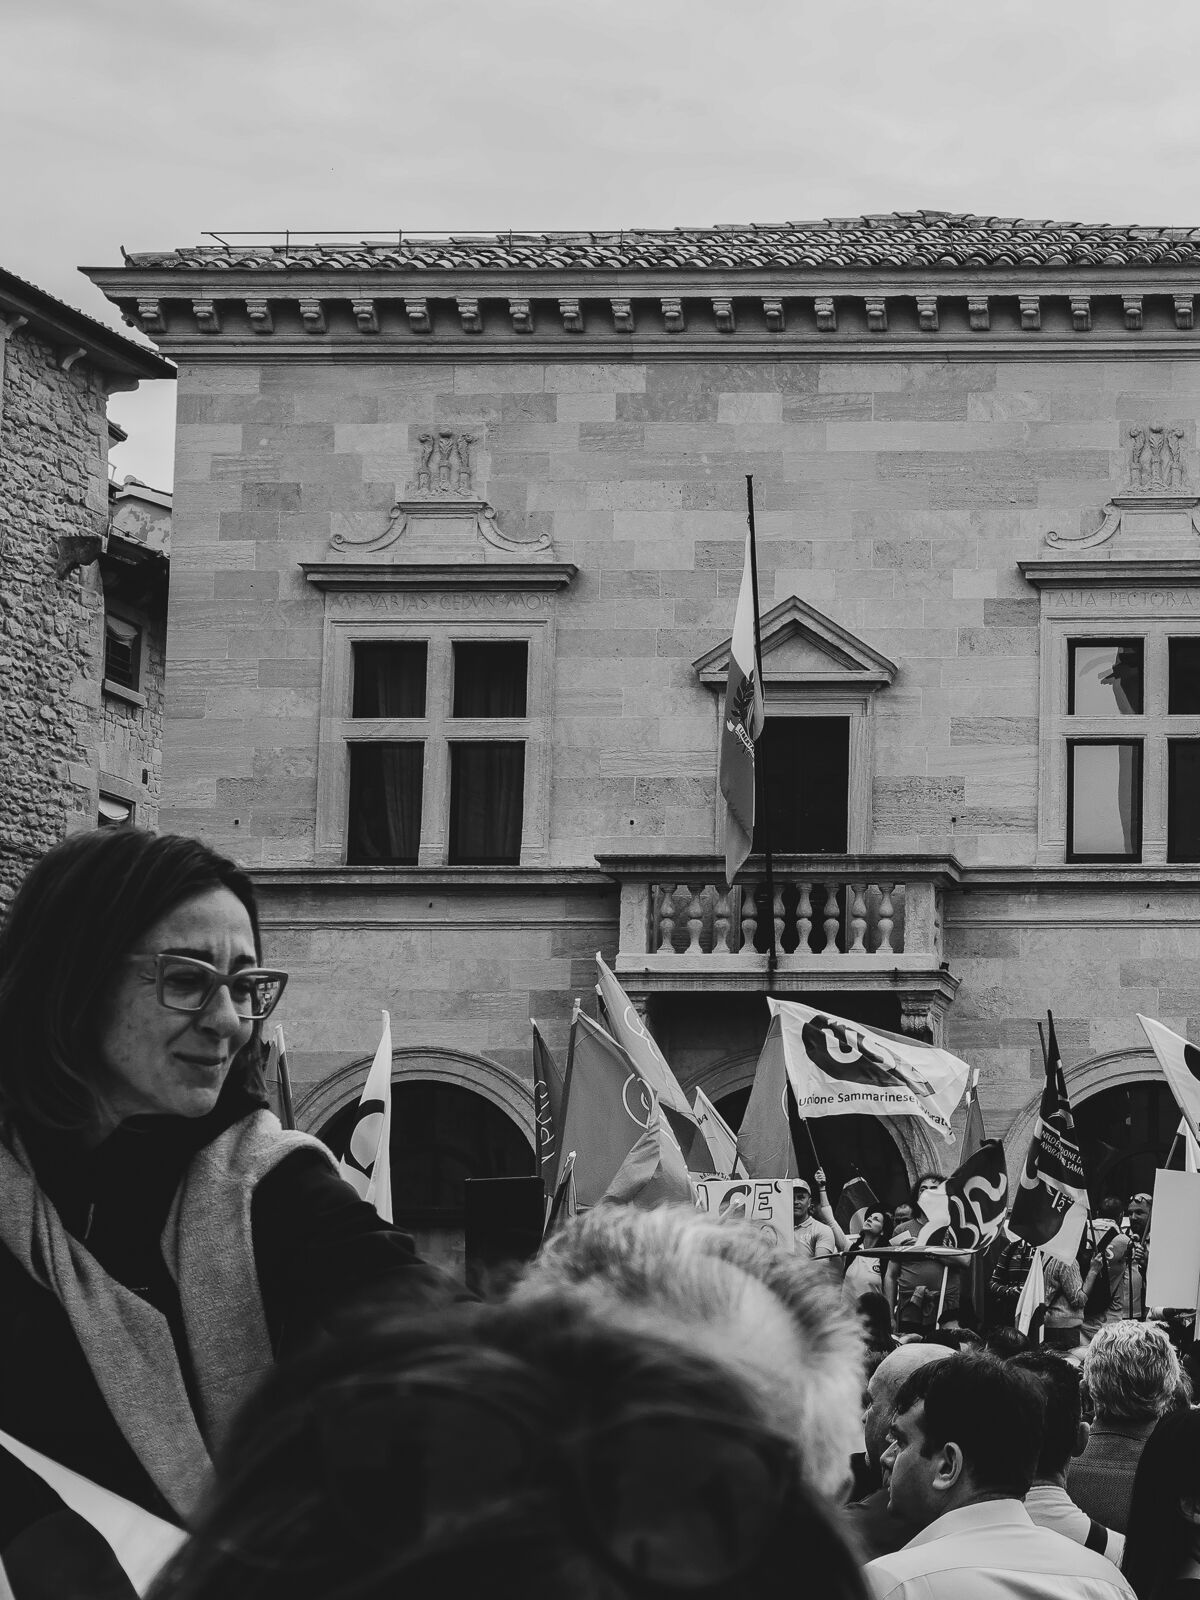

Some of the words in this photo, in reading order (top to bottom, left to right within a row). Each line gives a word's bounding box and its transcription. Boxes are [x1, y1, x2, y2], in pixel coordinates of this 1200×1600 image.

[1045, 591, 1097, 608] TALIA
[1109, 591, 1193, 608] PECTORA
[799, 1093, 834, 1107] Unione
[837, 1091, 915, 1103] Sammarinese
